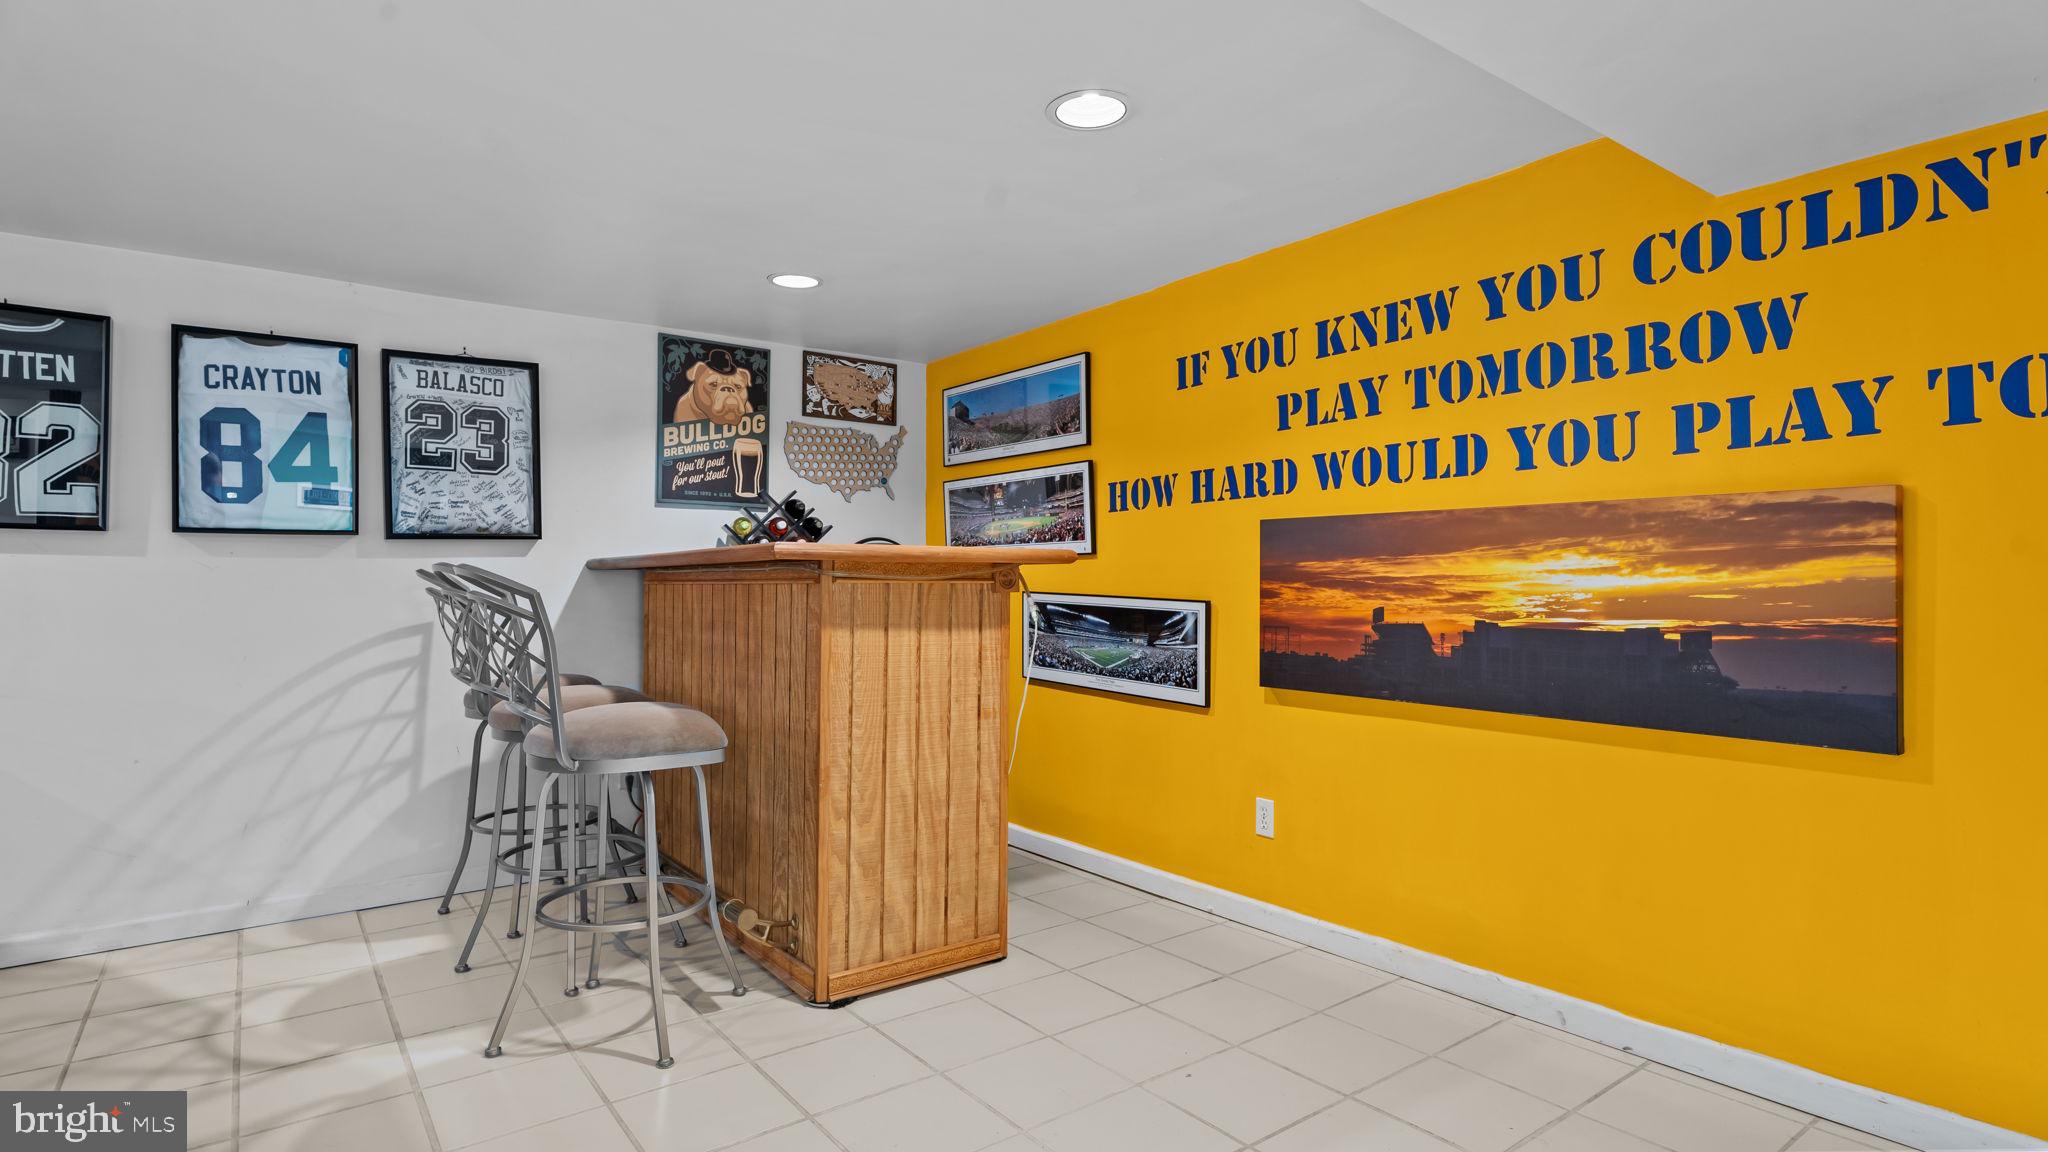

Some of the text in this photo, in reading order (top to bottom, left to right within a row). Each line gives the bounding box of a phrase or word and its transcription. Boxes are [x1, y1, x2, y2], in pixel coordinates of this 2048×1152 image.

[1176, 134, 2048, 390] IF YOU KNEW YOU COULDN'
[1277, 292, 1808, 431] PLAY TOMORROW
[204, 364, 321, 395] CRAYTON
[416, 369, 504, 397] BALASCO
[405, 399, 510, 475] 23
[664, 414, 765, 447] BULLDOG
[1108, 473, 1178, 513] HOW
[1190, 458, 1298, 504] HARD
[1312, 433, 1488, 491] WOULD
[1507, 410, 1640, 471] YOU
[1671, 375, 1894, 456] PLAY
[200, 407, 338, 504] 84
[664, 440, 728, 457] BREWING CO.
[672, 466, 730, 490] for our stout!
[676, 456, 725, 475] You'll pout
